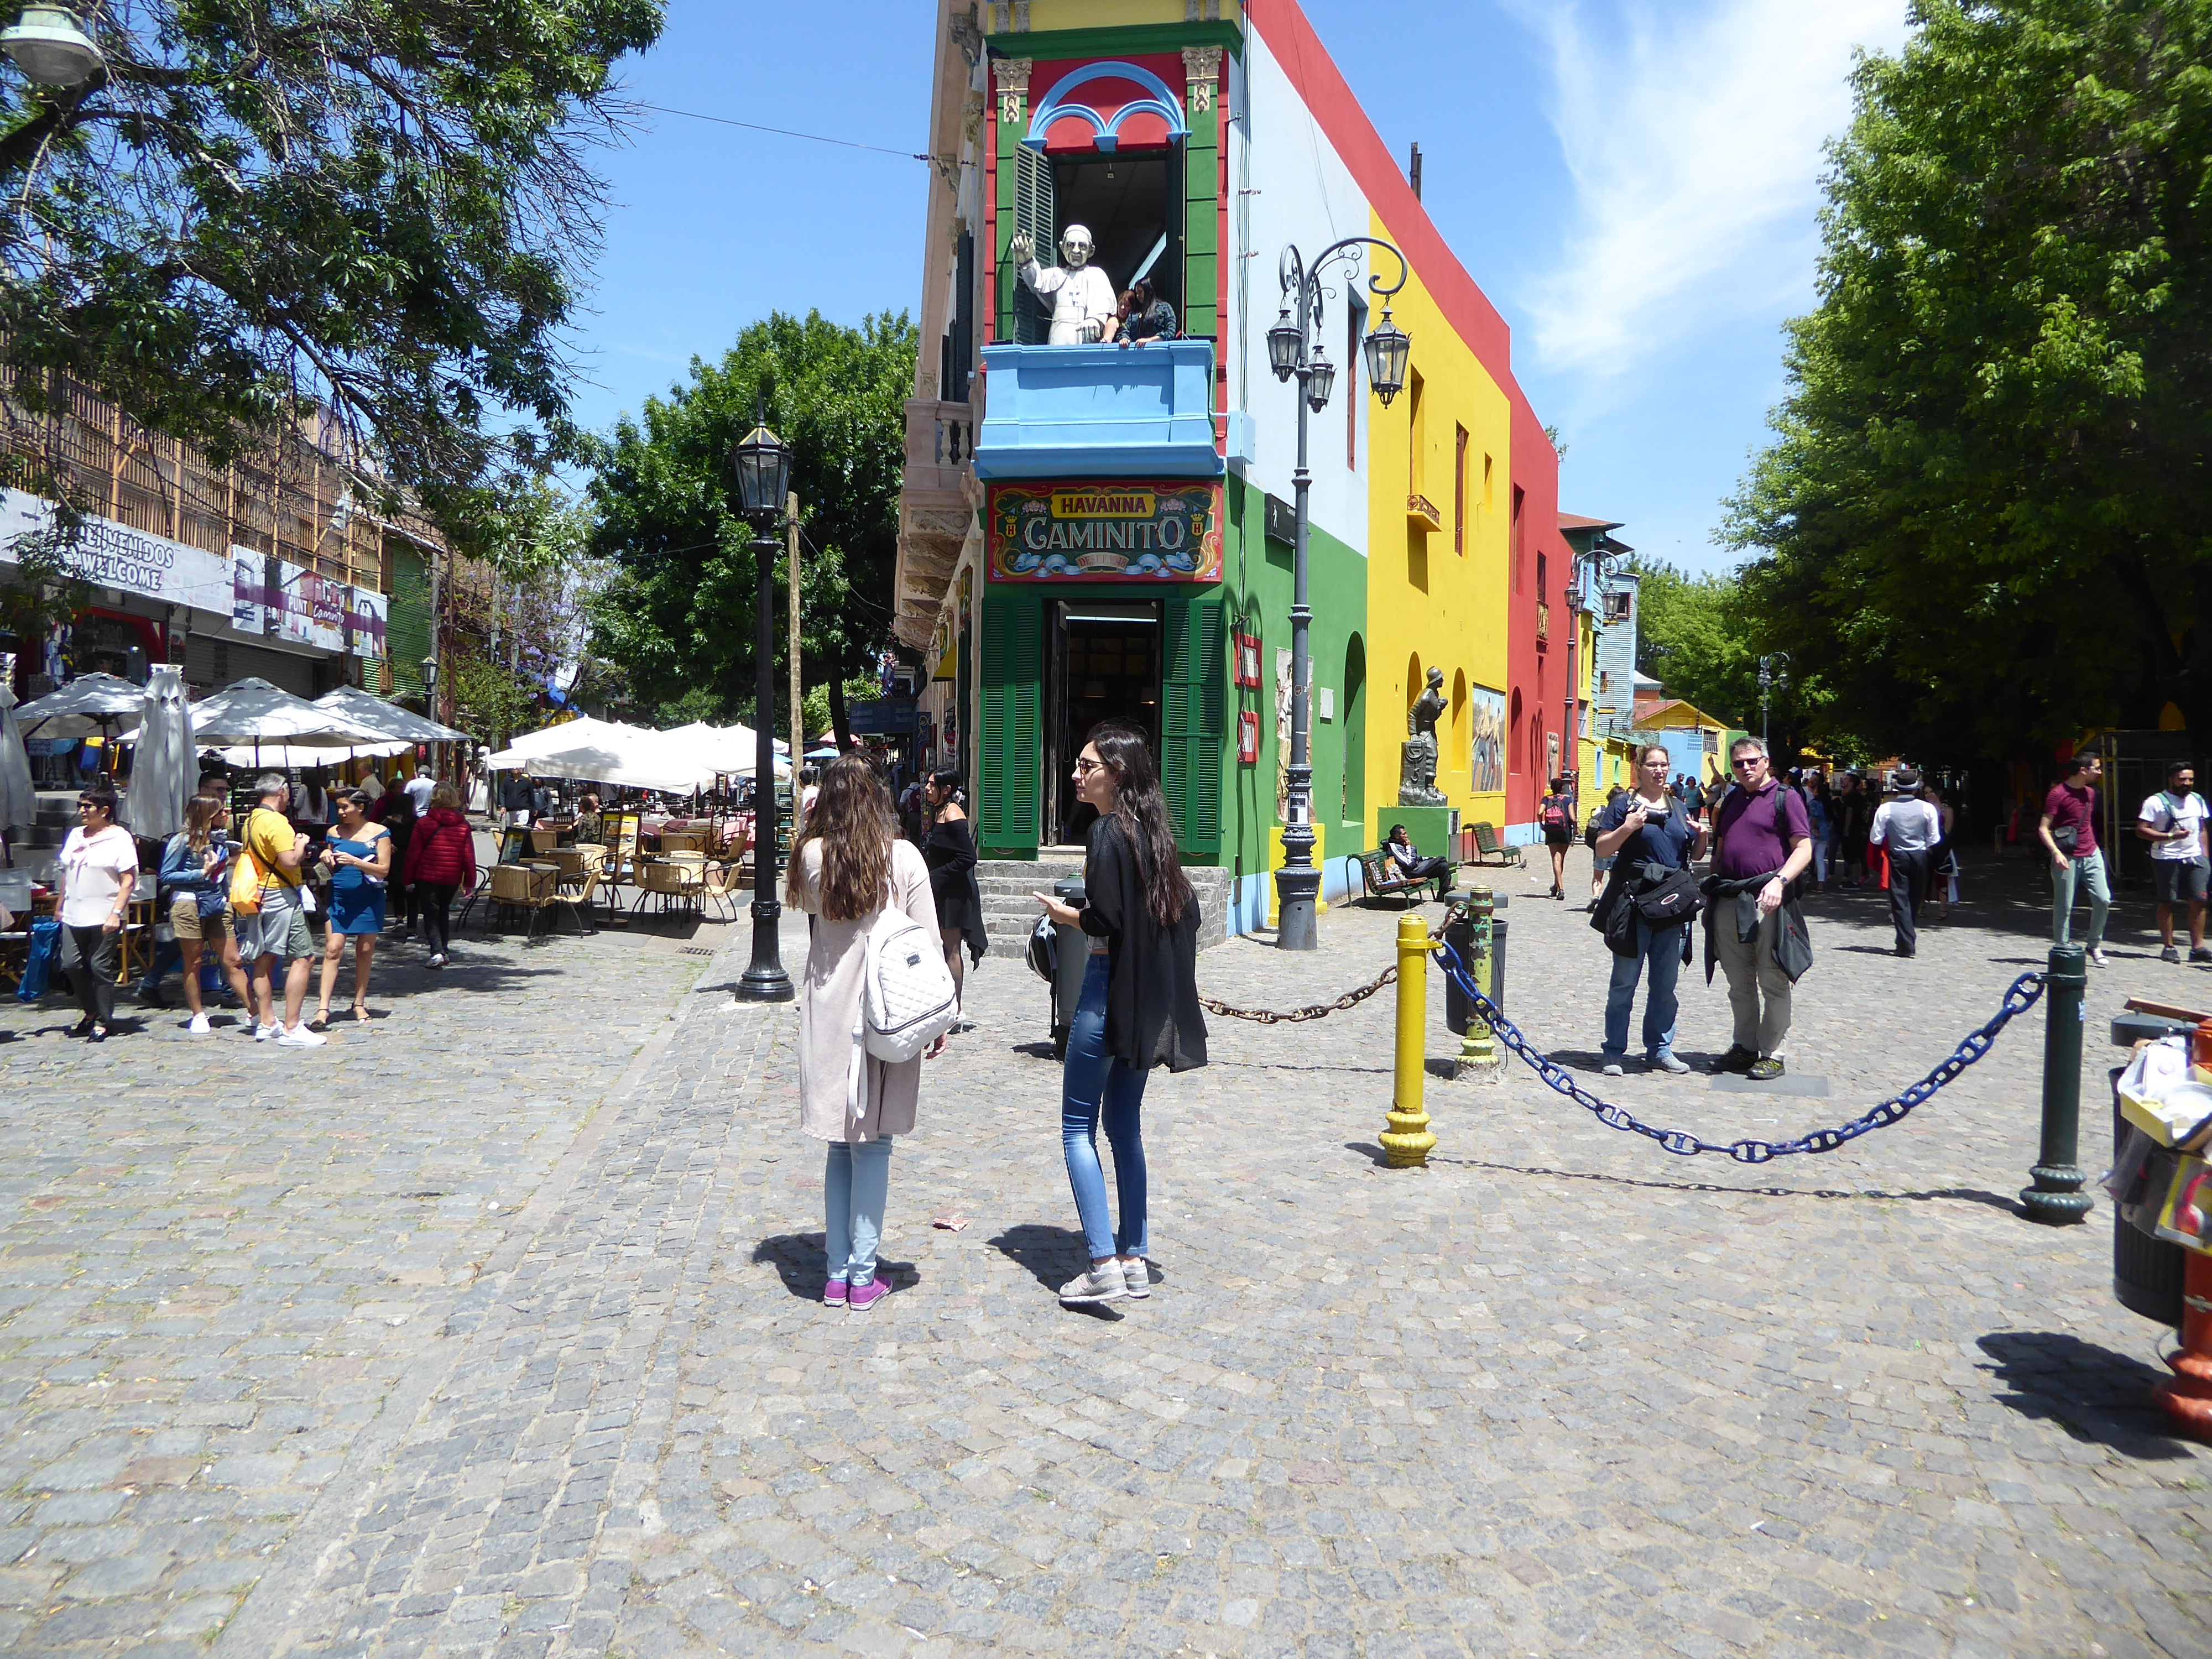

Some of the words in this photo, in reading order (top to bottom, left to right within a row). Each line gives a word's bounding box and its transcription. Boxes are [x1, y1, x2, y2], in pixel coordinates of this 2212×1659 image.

[1062, 497, 1147, 514] HAVANNA
[1008, 524, 1015, 535] H
[1024, 516, 1185, 550] CAMINITO
[1193, 523, 1201, 534] H
[81, 551, 163, 592] WELCOME
